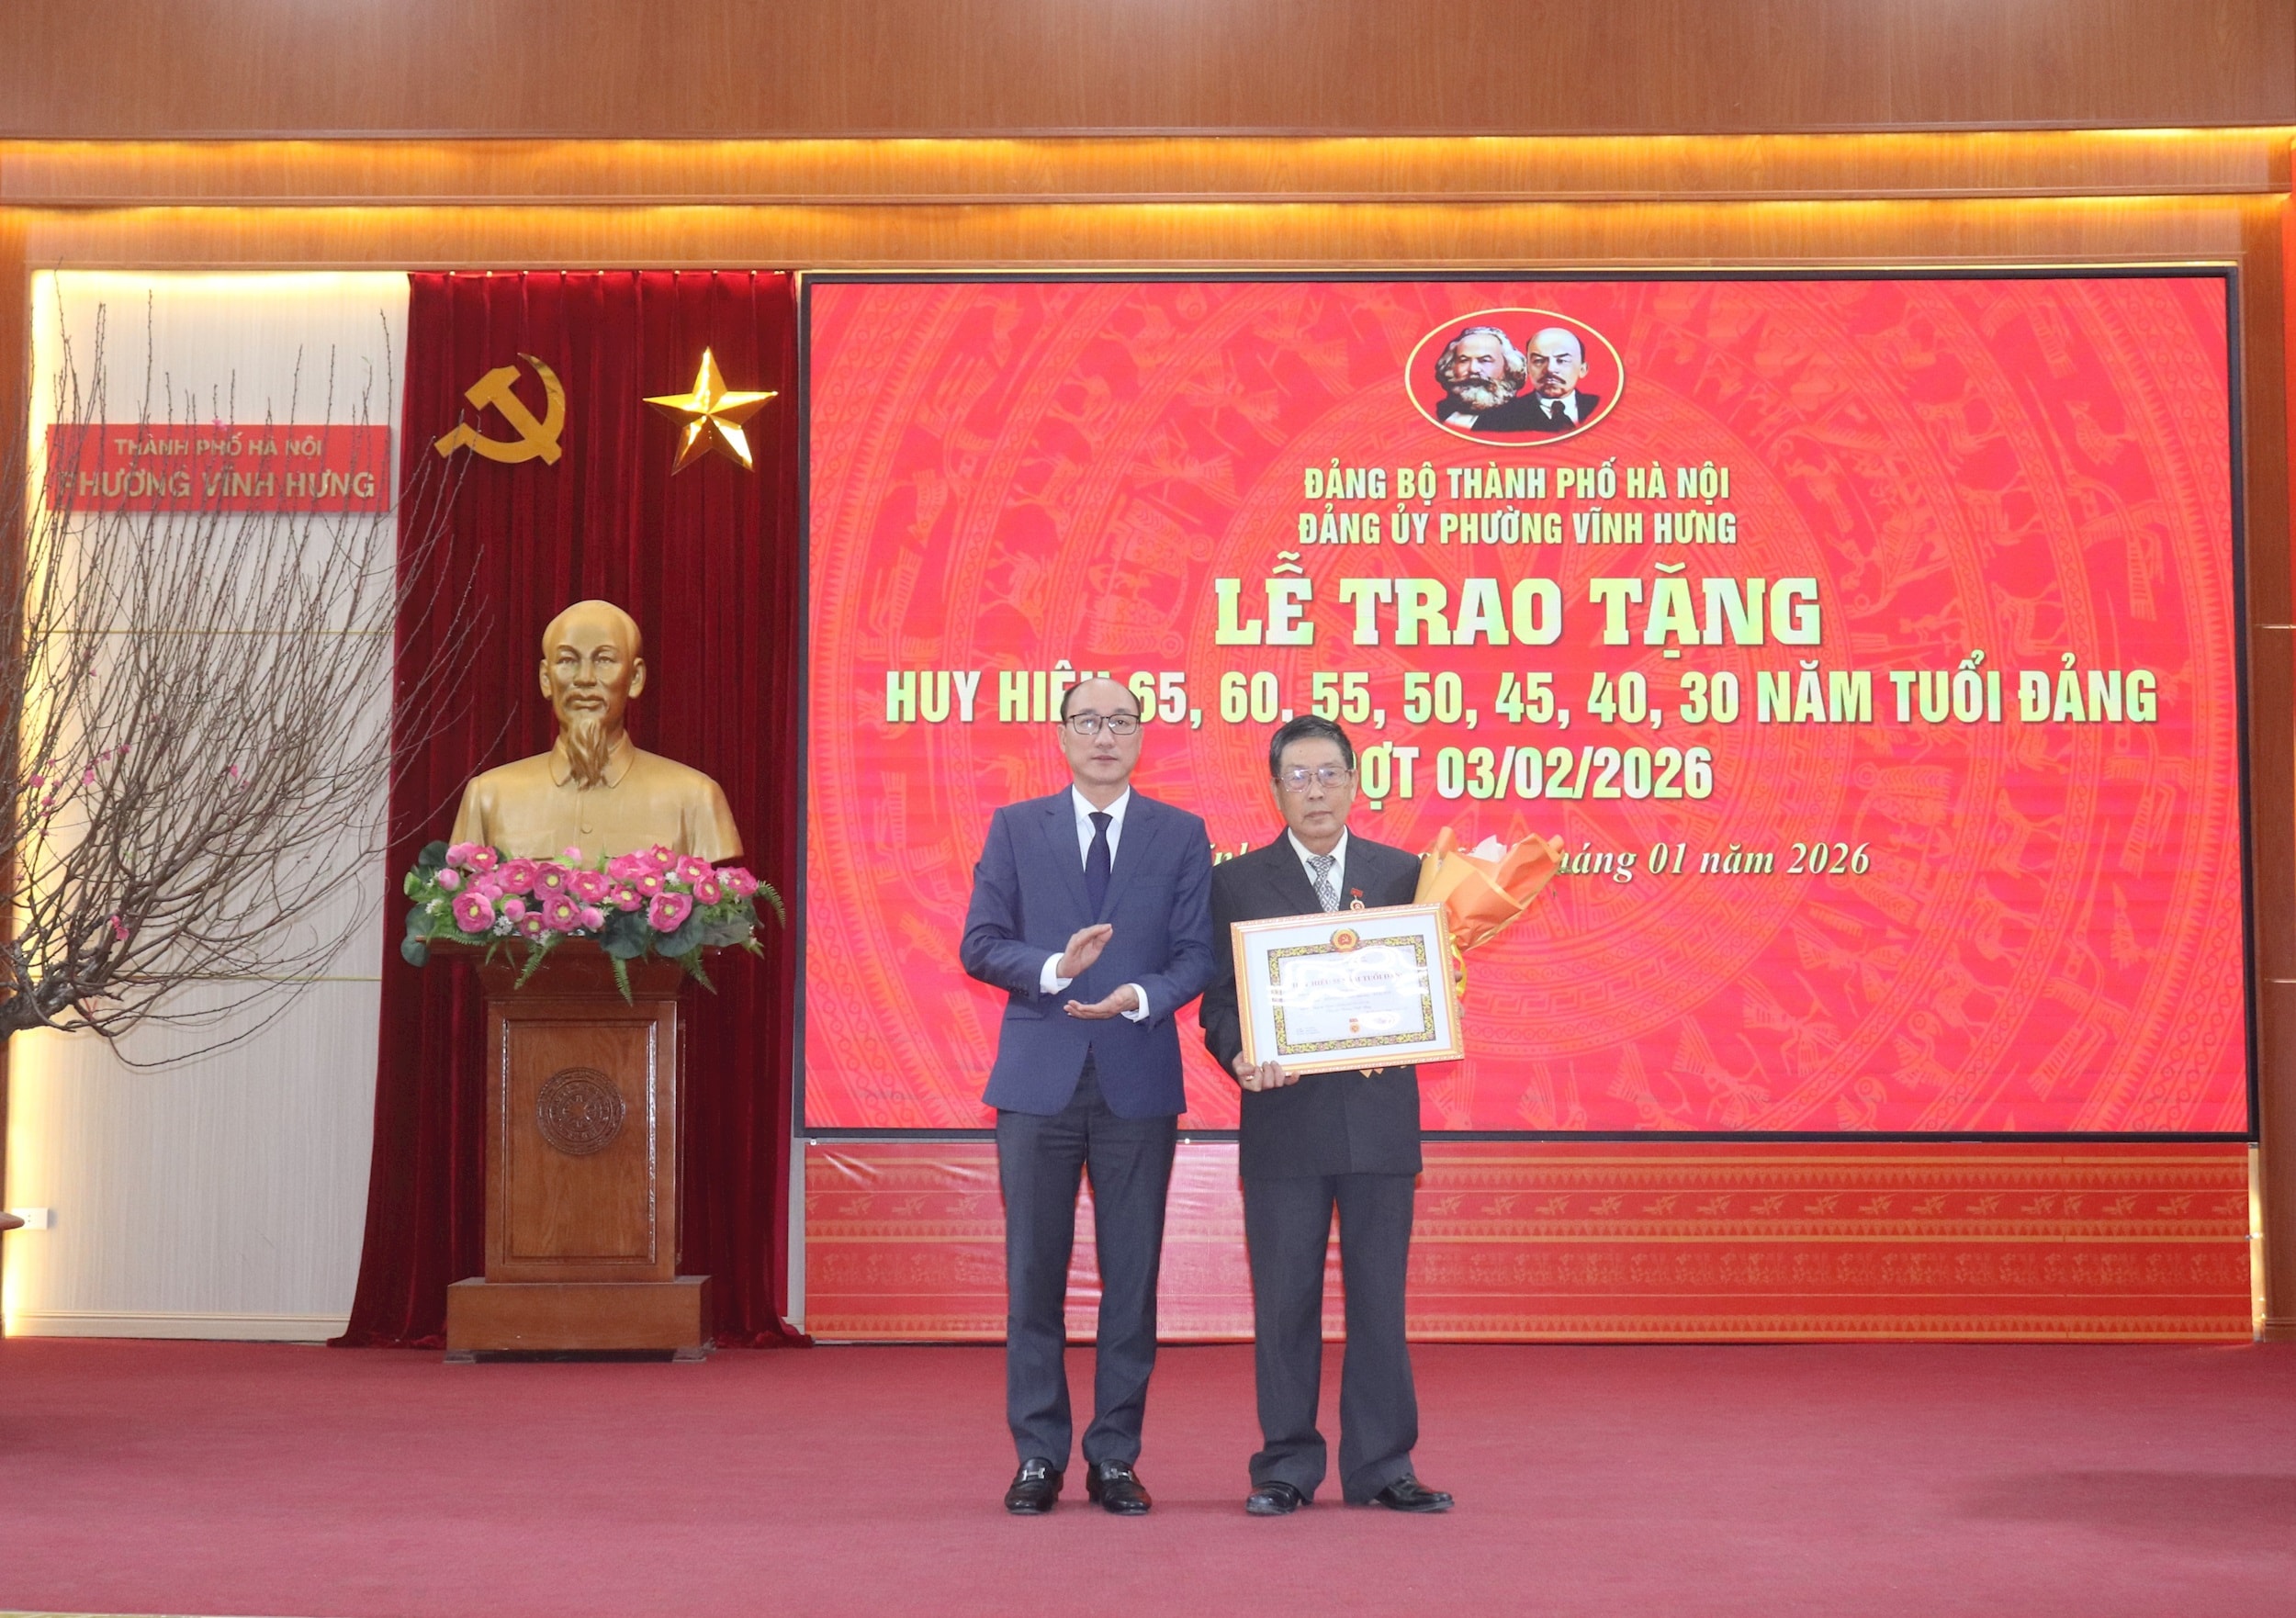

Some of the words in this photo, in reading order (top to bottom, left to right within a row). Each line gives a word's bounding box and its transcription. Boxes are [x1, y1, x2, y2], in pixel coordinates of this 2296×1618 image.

[114, 434, 188, 455] THÀNH
[196, 432, 242, 455] PHỐ
[248, 435, 278, 455] HÀ
[286, 435, 321, 459] NỘI
[202, 465, 275, 497] VĨNH
[286, 468, 375, 497] HƯNG
[1303, 457, 1387, 500] ĐẢNG
[1396, 461, 1436, 506] BỘ
[1446, 460, 1546, 500] THÀNH
[1556, 456, 1616, 499] PHỐ
[1626, 460, 1667, 499] HÀ
[1677, 460, 1729, 506] NỘI
[1298, 502, 1380, 545] ĐẢNG
[1390, 502, 1432, 545] ỦY
[1439, 505, 1562, 545] PHƯỜNG
[1571, 506, 1643, 544] VĨNH
[1653, 509, 1737, 545] HƯNG
[1214, 550, 1314, 646] LỄ
[1338, 578, 1562, 646] TRAO
[1589, 561, 1821, 658] TẶNG
[885, 670, 982, 723] HUY
[1128, 670, 1202, 728] 65,
[1311, 671, 1386, 730] 55,
[1403, 670, 1478, 730] 50,
[1494, 671, 1570, 730] 45,
[1587, 670, 1662, 730] 40,
[1680, 670, 1739, 724] 30
[1756, 659, 1872, 723] NĂM
[1889, 648, 2001, 723] TUỔI
[2018, 652, 2156, 723] ĐẢNG
[1352, 740, 1420, 810] ỢT
[1436, 746, 1713, 799] 03/02/2026
[1559, 842, 1638, 882] áng
[1649, 842, 1686, 874] 01
[1699, 843, 1773, 874] năm
[1786, 842, 1869, 874] 2026
